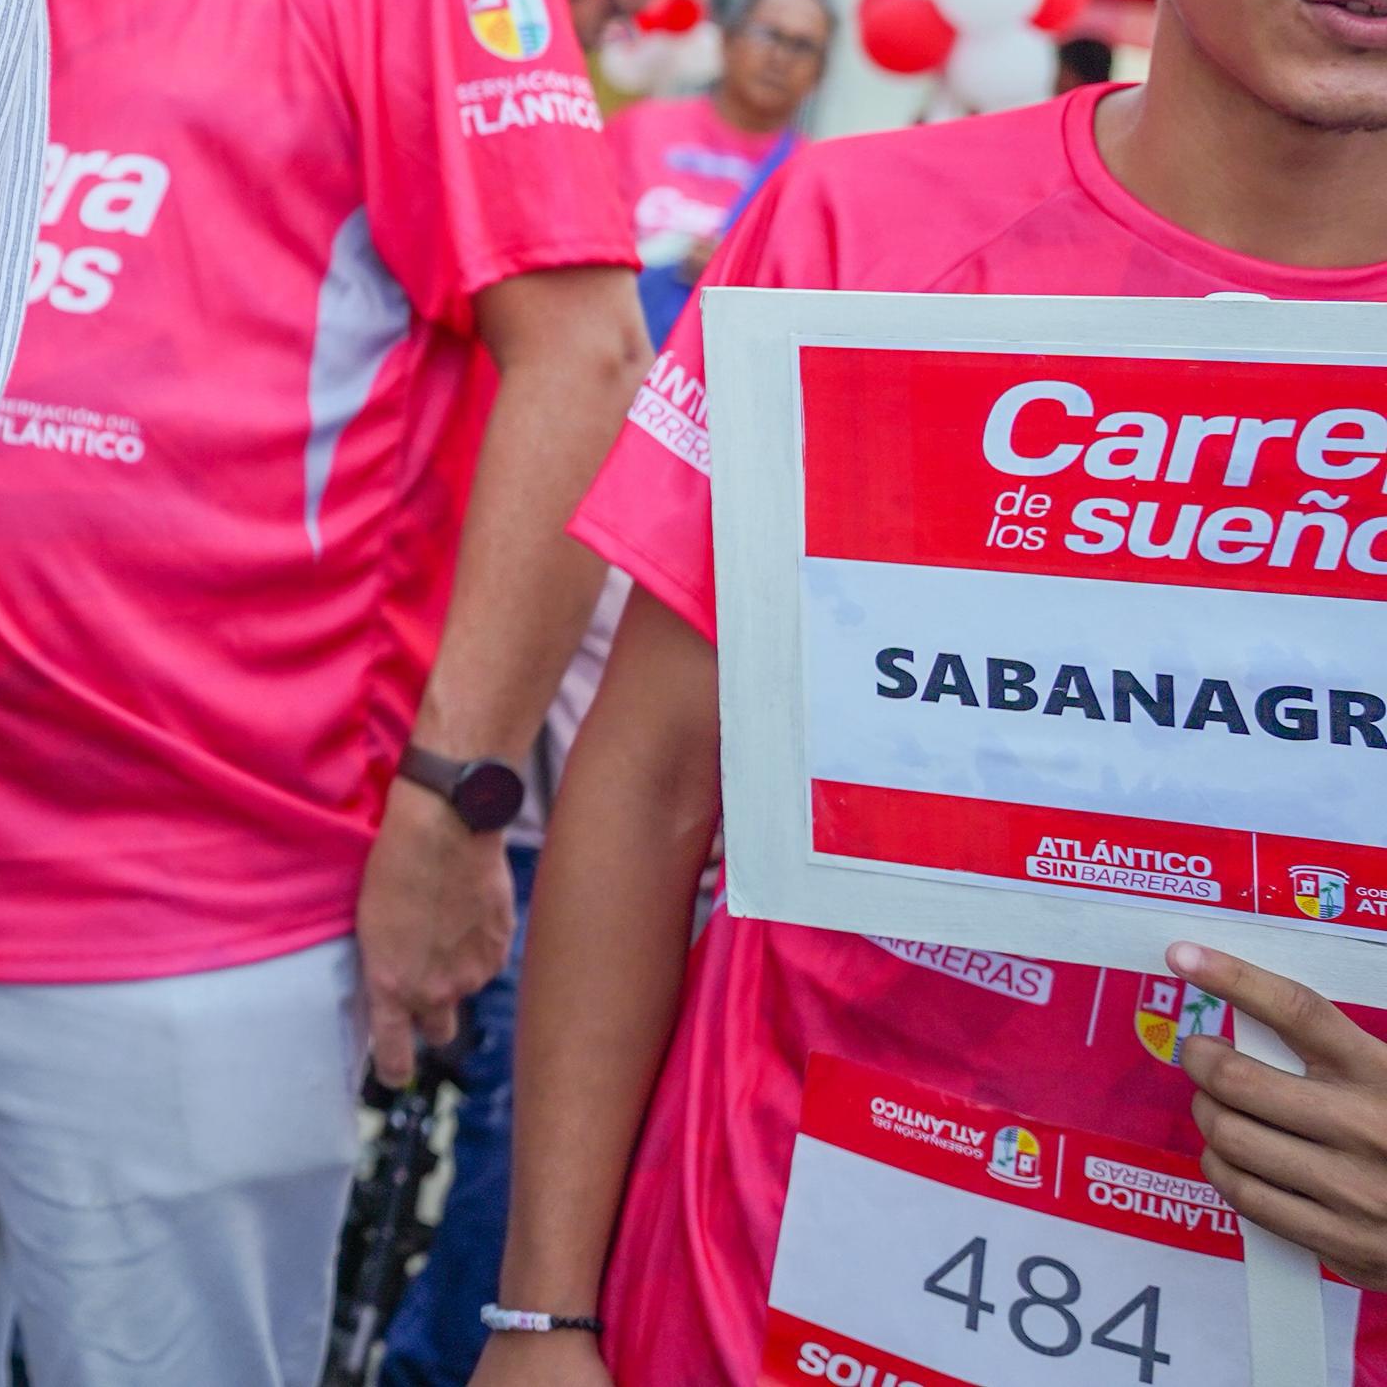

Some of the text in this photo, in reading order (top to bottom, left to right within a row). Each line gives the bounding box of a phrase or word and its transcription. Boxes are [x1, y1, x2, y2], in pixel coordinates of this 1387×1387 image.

[982, 380, 1387, 496] Carre
[994, 484, 1052, 517] de
[985, 516, 1047, 551] los
[874, 646, 1387, 750] SABANAGR
[1036, 836, 1212, 877] ATLÁNTICO
[1036, 860, 1212, 899] SIN BARRERAS
[922, 1234, 1171, 1386] 484
